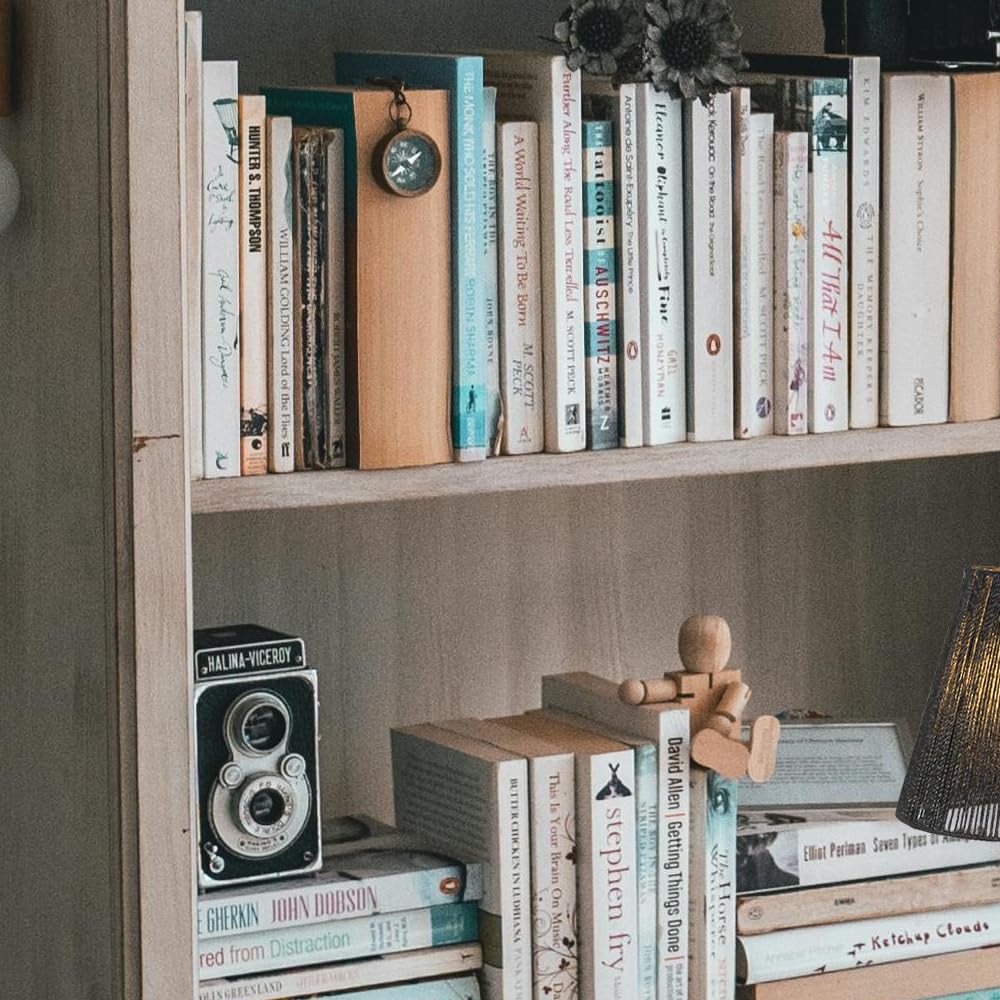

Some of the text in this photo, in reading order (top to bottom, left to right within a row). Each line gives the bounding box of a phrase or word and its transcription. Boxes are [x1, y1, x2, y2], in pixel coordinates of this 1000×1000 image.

[562, 73, 576, 117] Further
[917, 93, 926, 132] WILLIAM
[561, 121, 574, 153] Along
[624, 95, 633, 152] Antoine de
[863, 78, 871, 187] KIM EDWARDS
[248, 126, 263, 253] HUNTER S. THOMPSON
[563, 159, 576, 181] The
[707, 120, 717, 218] Kerouac On Road
[563, 187, 575, 215] Road
[654, 104, 671, 324] Eleanor Oliphant Fine
[512, 136, 531, 327] A World Waiting To Be Born
[563, 220, 574, 244] Less
[593, 151, 611, 365] tattooist AUSCHWITZ
[822, 220, 843, 382] All That I Am
[857, 283, 865, 357] DAUGHTER
[866, 274, 874, 329] MEMORY
[278, 227, 292, 439] WILLIAM GOLDING Lord the Flies
[513, 360, 523, 396] PECK
[566, 323, 577, 395] SCOTT PECK
[667, 351, 679, 374] GAIL
[759, 349, 768, 387] PECK
[523, 364, 534, 411] SCOTT
[914, 377, 924, 416] PICADOR
[207, 647, 292, 673] HALINA-VICEROY
[510, 778, 521, 870] BUTTER CHICKEN
[664, 737, 684, 953] David Allen Getting Things Done
[804, 844, 827, 863] Elliot
[830, 841, 866, 859] Perlman
[873, 837, 898, 853] Seven
[903, 832, 928, 850] Types
[549, 772, 563, 949] This Is Your Brain On Music
[207, 885, 378, 933] GHERKIN JOHN DOBSON
[600, 808, 632, 972] stephen fry
[719, 882, 731, 945] Horse
[834, 897, 856, 906] EMMA
[229, 941, 265, 964] from
[269, 929, 350, 958] Distraction
[872, 920, 990, 952] Ketchup Clouds
[224, 981, 283, 1000] GREENLAND
